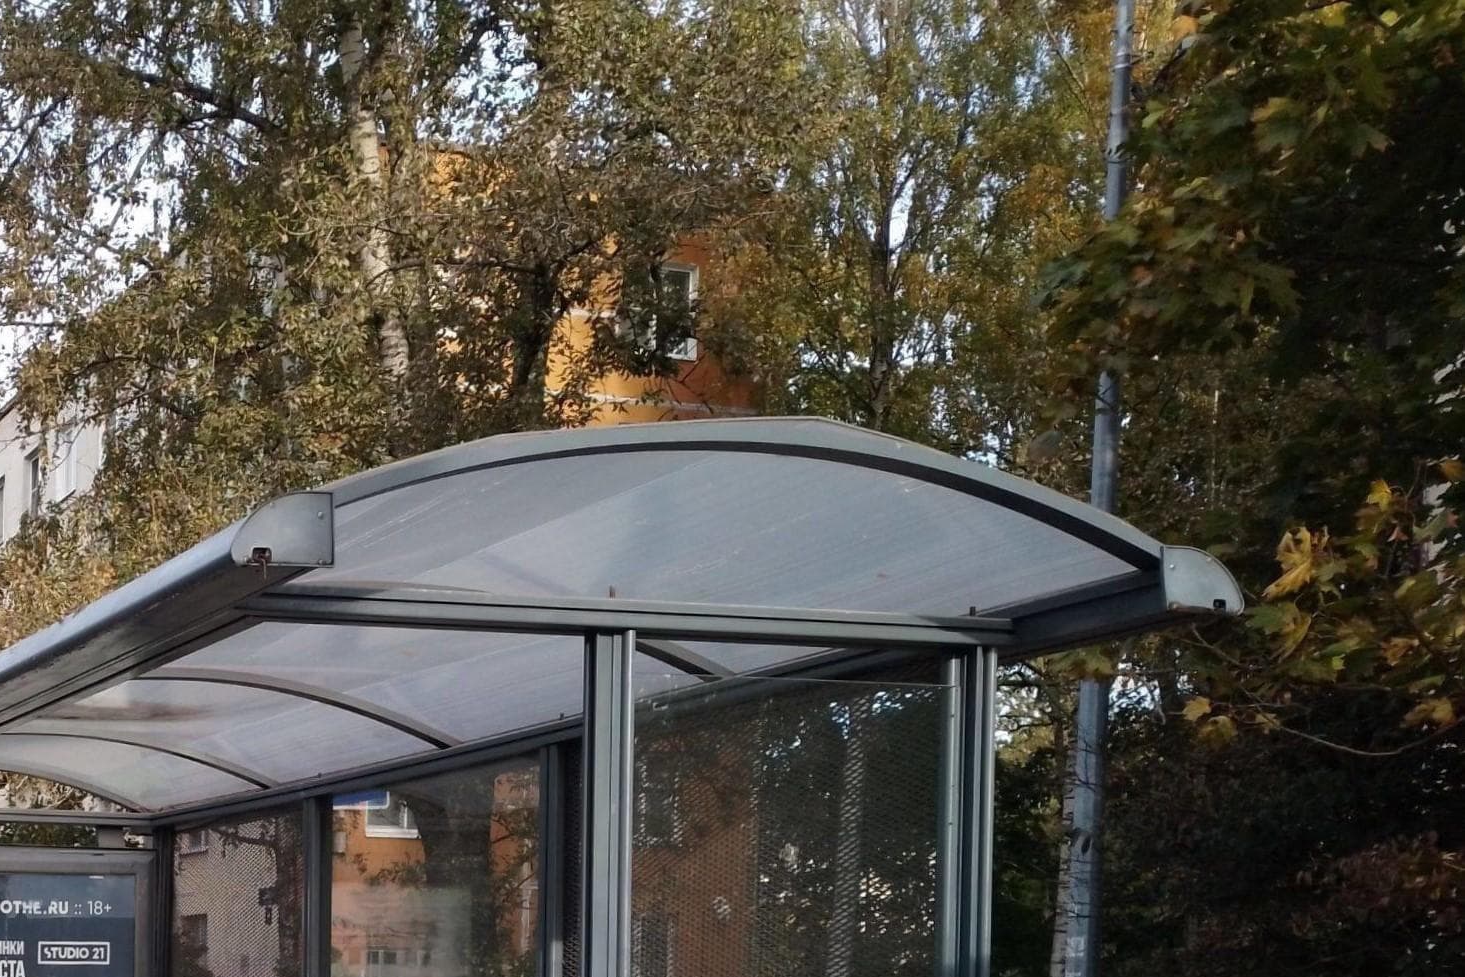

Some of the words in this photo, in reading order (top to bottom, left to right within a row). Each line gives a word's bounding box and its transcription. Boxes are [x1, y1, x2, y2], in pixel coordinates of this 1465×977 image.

[87, 901, 112, 915] 18+
[44, 947, 89, 960] STUDIO
[92, 947, 105, 960] 21
